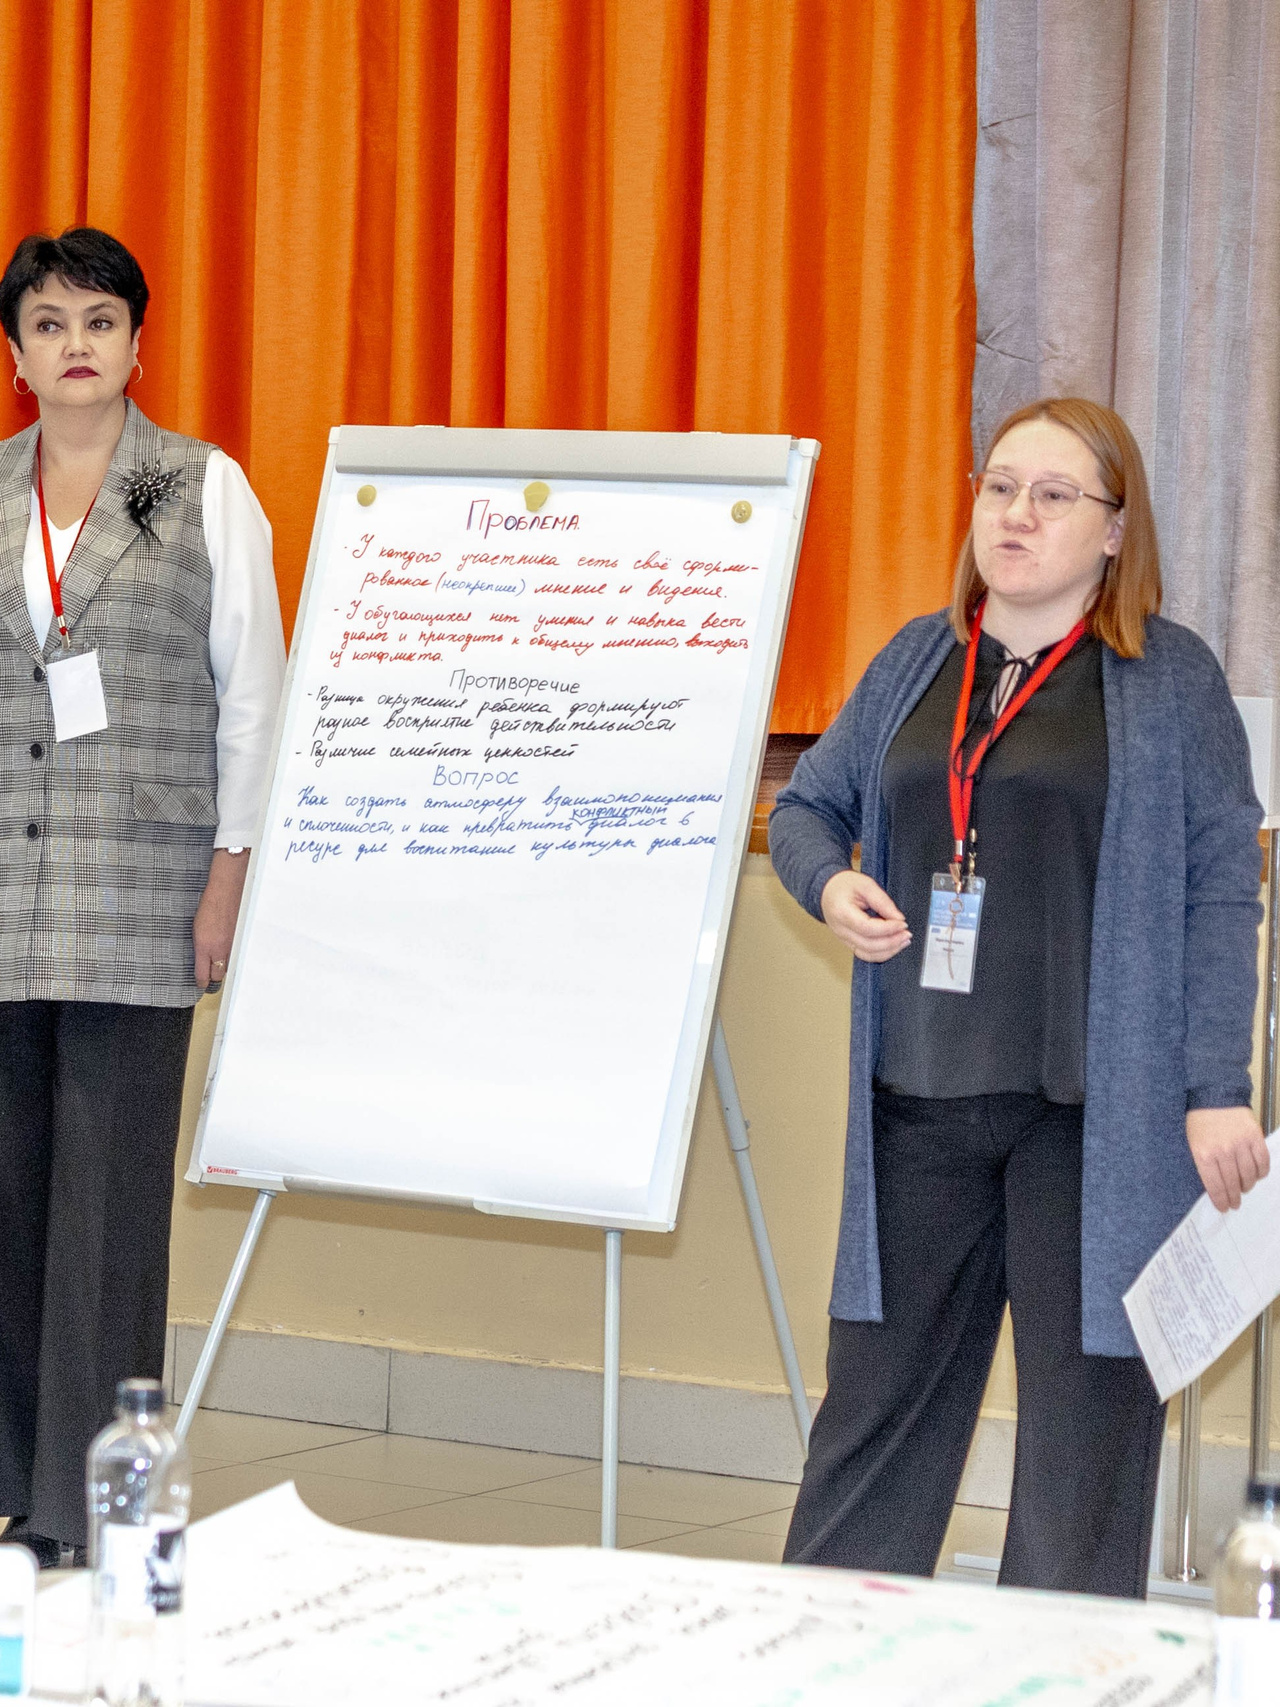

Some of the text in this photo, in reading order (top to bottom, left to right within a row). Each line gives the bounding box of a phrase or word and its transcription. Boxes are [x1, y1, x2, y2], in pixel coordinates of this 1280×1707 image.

[352, 534, 760, 577] У каждого участника есть своё сформи-
[360, 569, 432, 593] рованное
[534, 583, 608, 594] мнение
[619, 585, 633, 594] и
[346, 600, 747, 632] У обучающихся нет умения и навыка вести
[340, 630, 749, 656] диалог и приходить к общему мнению, выходить
[329, 649, 444, 668] из конфликта.
[449, 668, 580, 696] Противоречие
[316, 685, 691, 719] Разница окружения ребенка формируют
[312, 709, 676, 741] разное восприятие действительности
[309, 740, 579, 768] Различие семейных ценностей
[432, 764, 519, 790] Вопрос
[297, 785, 723, 818] Как создать атмосферу взаимопонимания
[283, 811, 695, 838] и сплоченности, и как превратить диалог в
[284, 841, 343, 863] ресурс
[355, 842, 388, 861] для
[530, 838, 637, 860] культуры
[646, 834, 718, 855] диалога
